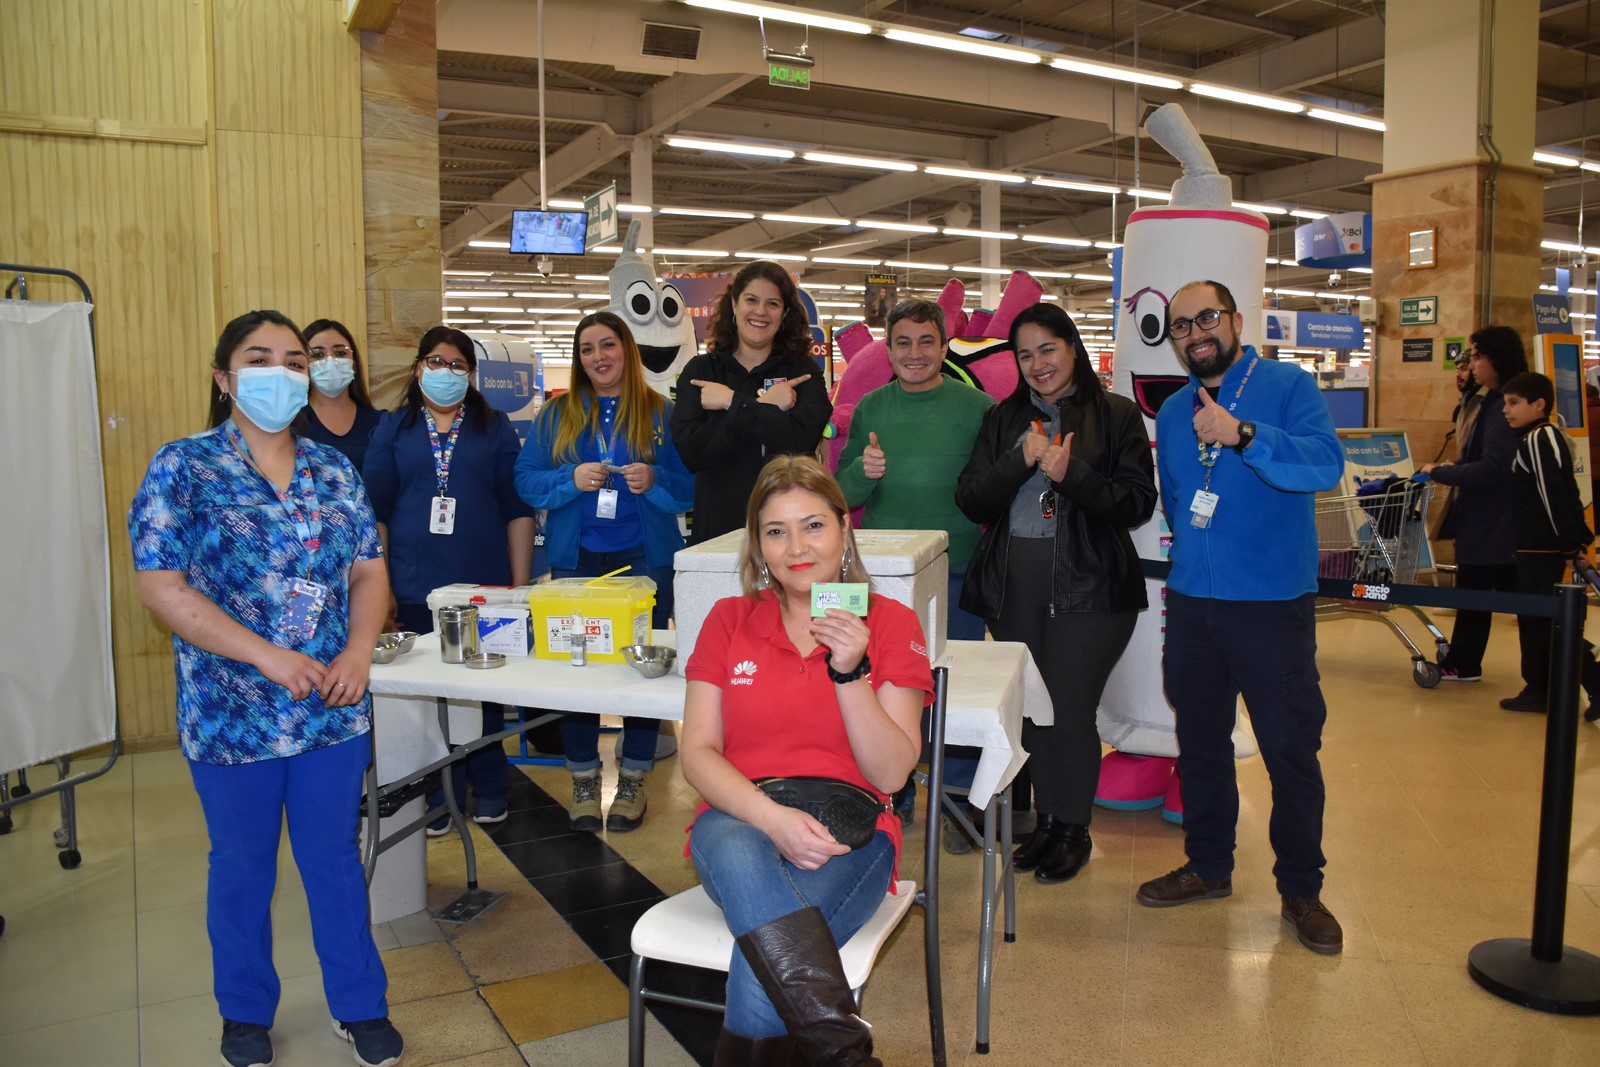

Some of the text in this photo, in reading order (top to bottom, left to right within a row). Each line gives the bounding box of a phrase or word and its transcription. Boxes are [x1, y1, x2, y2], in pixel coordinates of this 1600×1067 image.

[1349, 227, 1362, 237] Bci
[686, 306, 714, 317] TOÑ
[1535, 304, 1558, 315] Pago de
[1537, 314, 1560, 324] Cuentas
[1307, 323, 1325, 331] Centro
[1332, 324, 1354, 333] atención
[484, 376, 497, 389] Solo
[496, 379, 507, 389] con
[1229, 402, 1237, 411] 10
[1364, 469, 1392, 477] Acumulas
